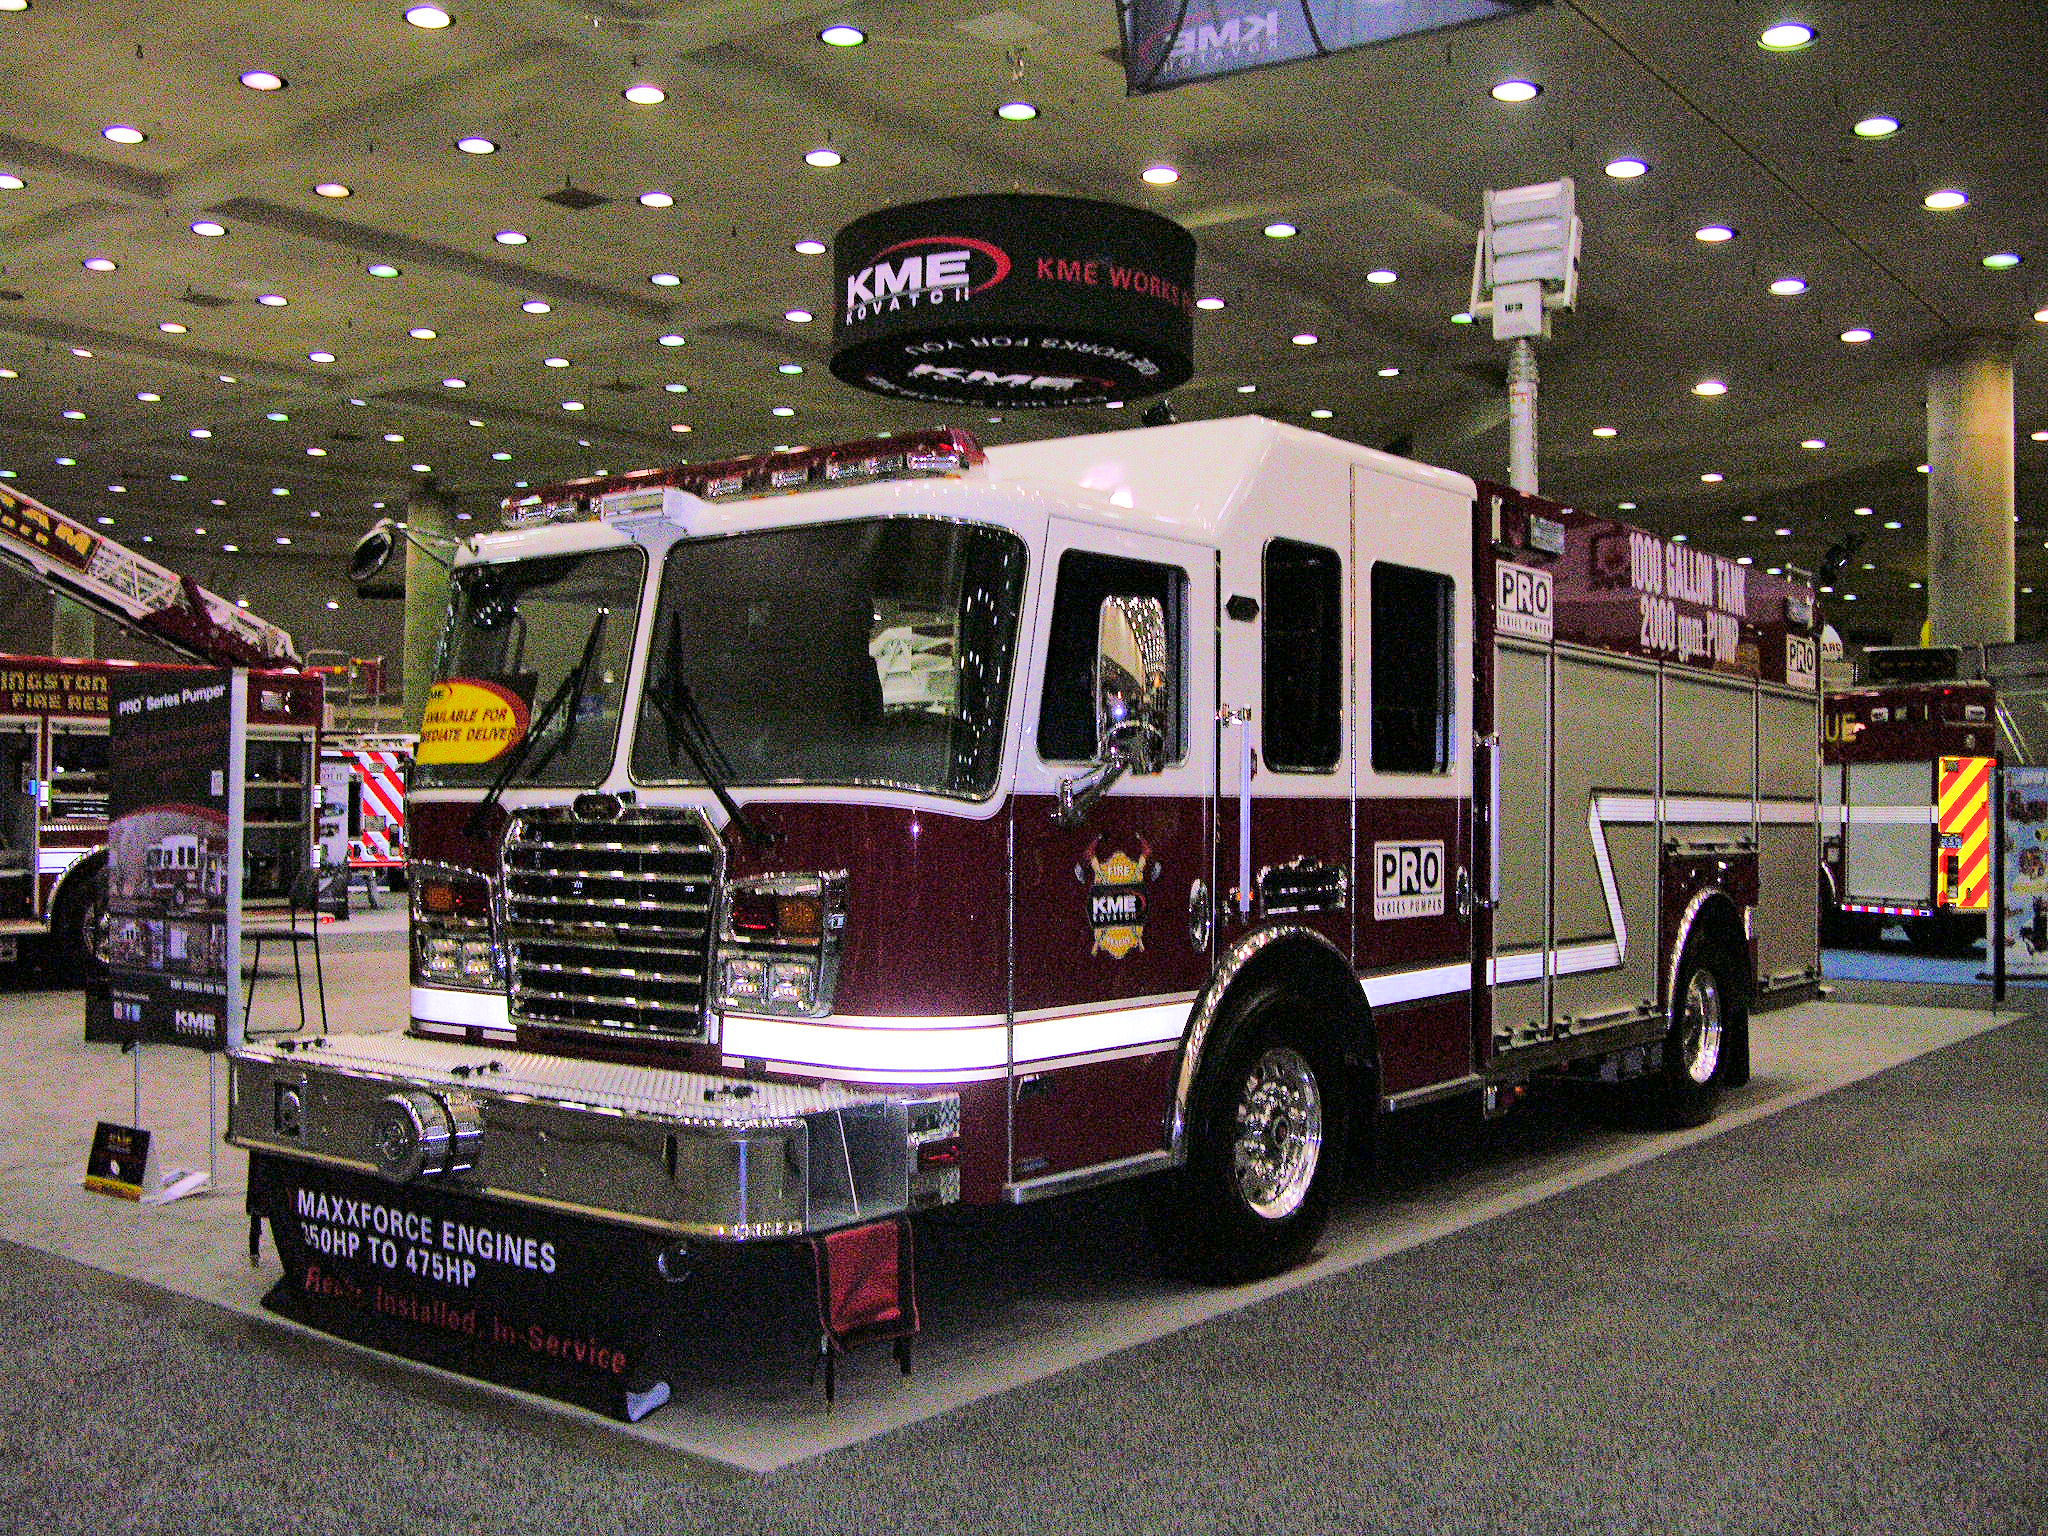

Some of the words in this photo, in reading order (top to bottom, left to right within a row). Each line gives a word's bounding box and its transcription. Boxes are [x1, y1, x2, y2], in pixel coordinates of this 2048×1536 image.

[847, 250, 971, 308] KME
[1037, 257, 1098, 285] KME
[1501, 570, 1549, 615] PRO
[1789, 643, 1814, 671] PRO
[11, 691, 63, 709] FIRE
[146, 693, 181, 711] Series
[181, 684, 226, 705] Pumper
[482, 707, 509, 721] FOR
[1108, 865, 1131, 876] FIRE
[1382, 852, 1439, 892] PRO
[1092, 895, 1137, 914] KME
[1376, 901, 1406, 916] SERIES
[298, 1189, 433, 1246] MAXXFORCE
[442, 1220, 557, 1274] ENGINES
[368, 1236, 398, 1270] TO
[405, 1248, 477, 1289] 475HP
